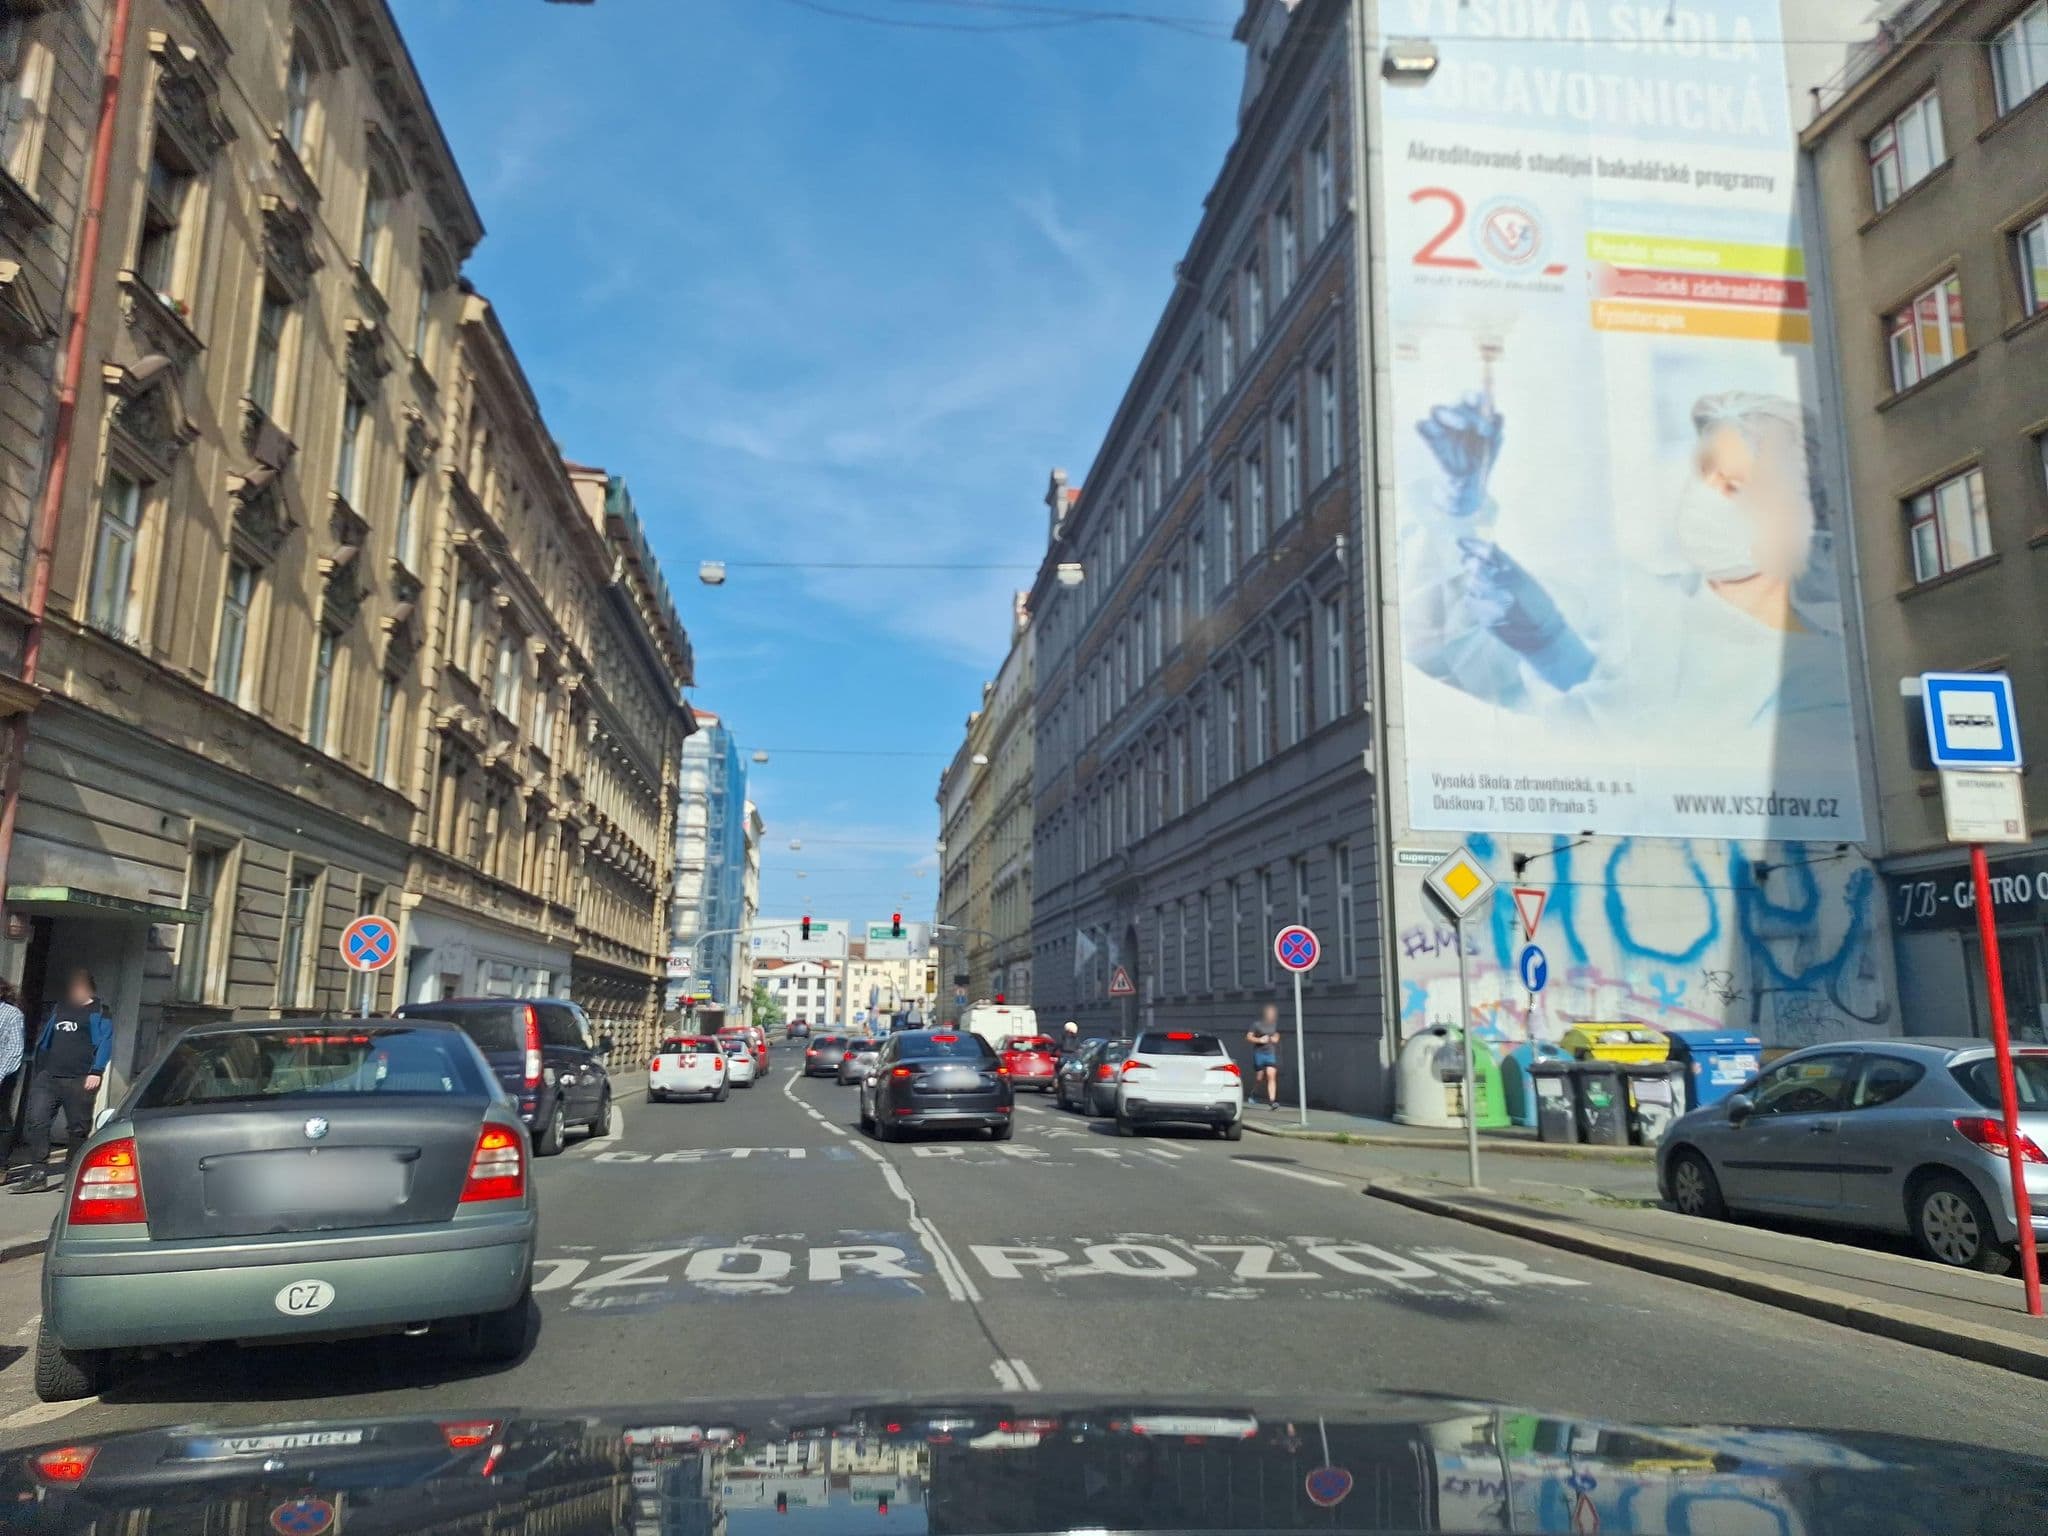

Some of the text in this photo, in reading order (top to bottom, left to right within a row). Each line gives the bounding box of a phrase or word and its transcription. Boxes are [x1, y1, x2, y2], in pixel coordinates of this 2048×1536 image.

[1408, 57, 1770, 135] DRAVOTNICKÁ
[1408, 140, 1522, 170] Akreditované
[1695, 169, 1773, 194] programy
[1432, 774, 1475, 790] Vysoká
[1478, 775, 1511, 790] škola
[1502, 797, 1524, 812] 150
[1588, 799, 1598, 814] 5
[1673, 791, 1840, 818] www.vszdrav.cz
[969, 1243, 1591, 1288] POZOR
[288, 1285, 321, 1310] CZ
